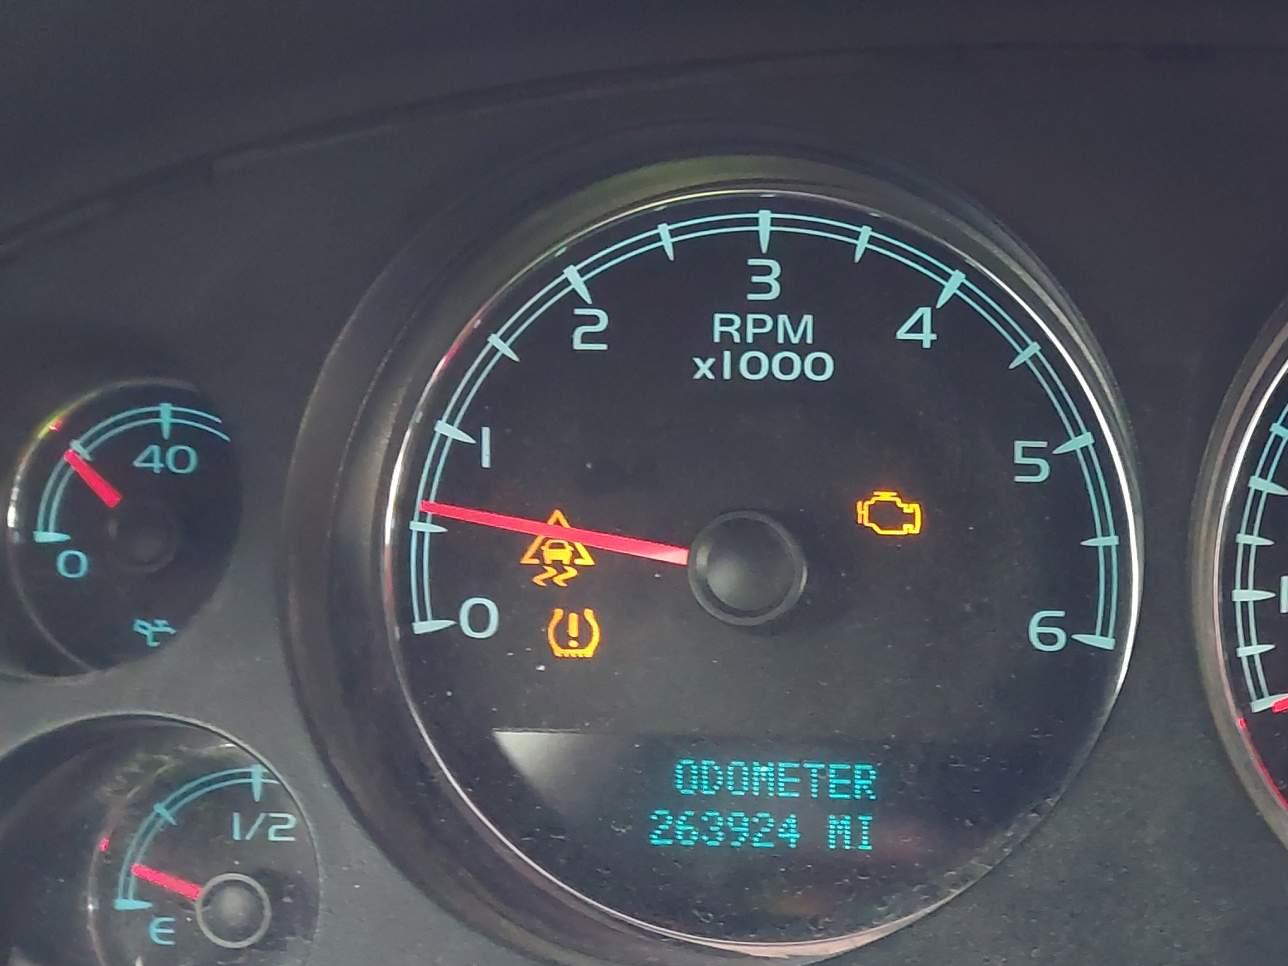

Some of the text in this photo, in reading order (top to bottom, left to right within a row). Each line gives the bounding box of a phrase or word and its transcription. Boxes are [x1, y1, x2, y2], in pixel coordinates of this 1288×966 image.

[747, 258, 781, 301] 3
[572, 308, 609, 350] 2
[713, 313, 814, 344] RPM
[896, 307, 937, 349] 4
[692, 351, 835, 382] x1000
[132, 445, 199, 475] 40
[480, 427, 492, 468] 1
[1013, 441, 1051, 483] 5
[56, 550, 89, 579] 0
[460, 598, 499, 639] 0
[1028, 610, 1067, 652] 6
[674, 759, 878, 800] ODOMETER
[231, 812, 297, 842] 1/2
[649, 809, 873, 851] 263924 MI
[149, 917, 176, 945] E
